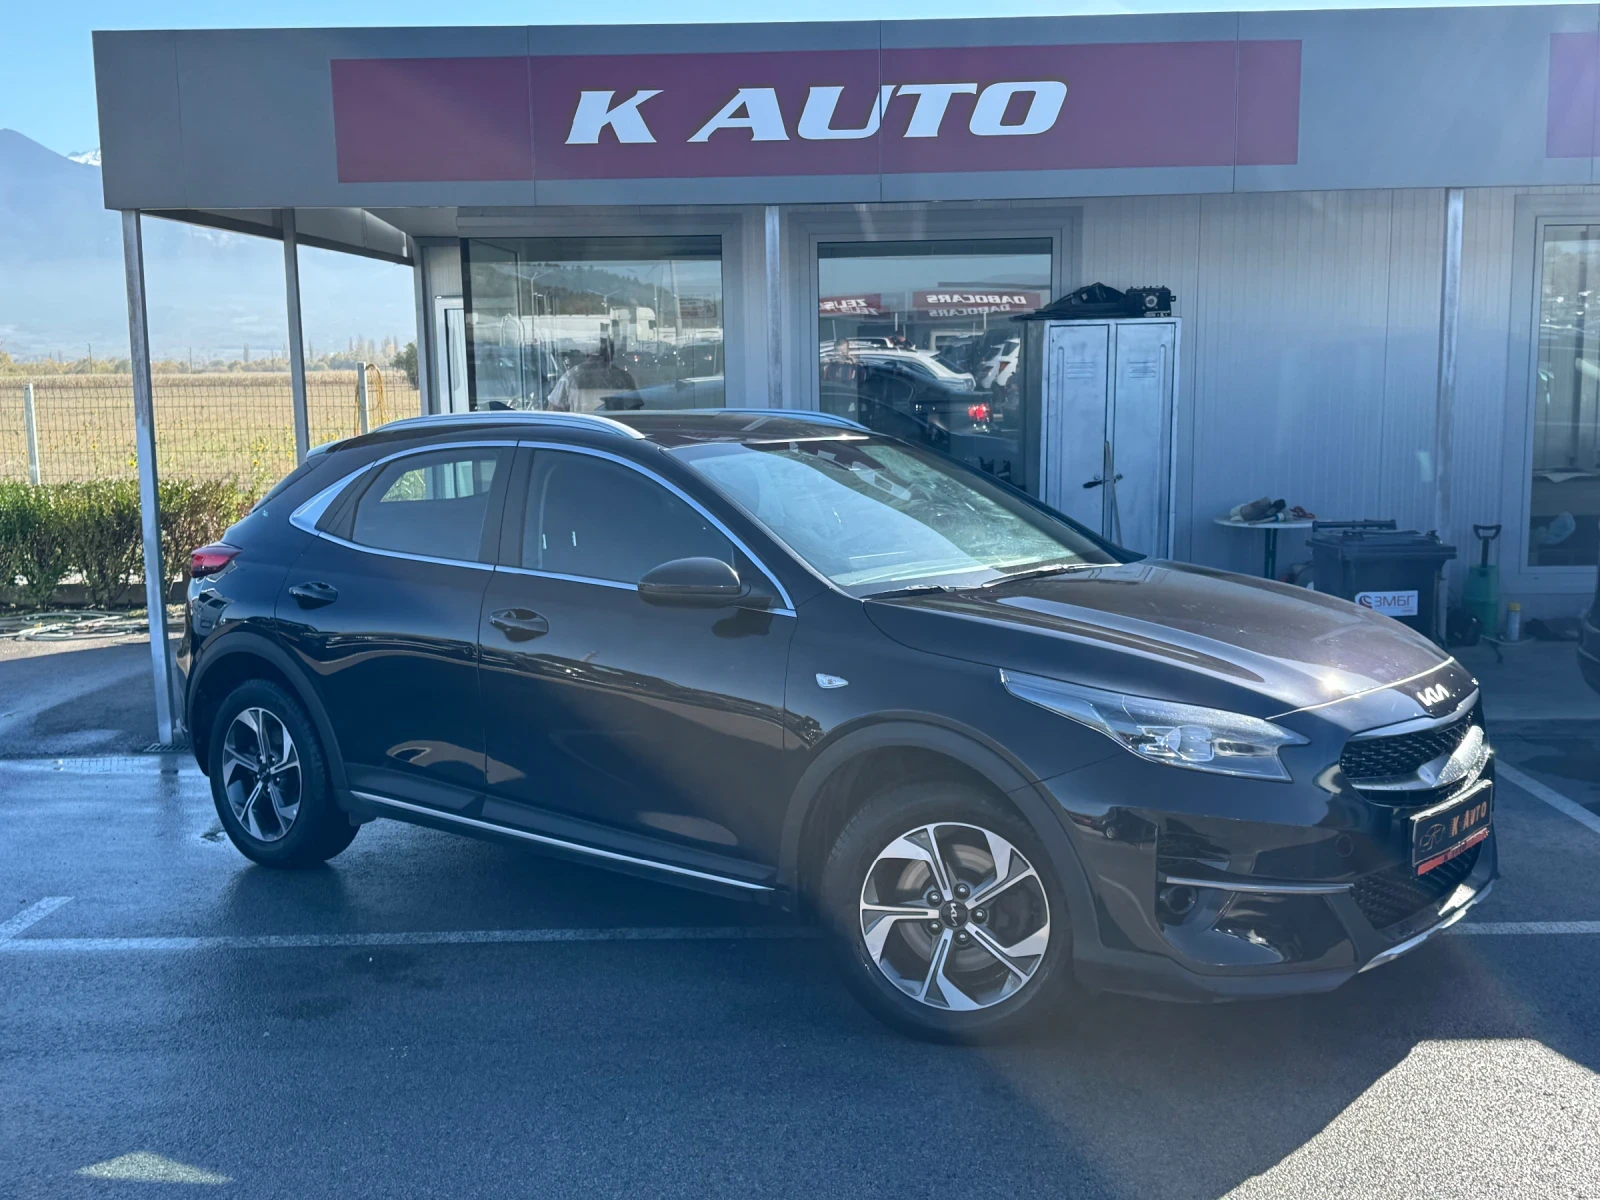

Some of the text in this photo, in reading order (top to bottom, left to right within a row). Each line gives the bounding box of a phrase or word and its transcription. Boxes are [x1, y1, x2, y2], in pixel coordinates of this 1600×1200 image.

[565, 80, 1068, 143] K AUTO
[1374, 594, 1415, 608] ЗМБГ
[1416, 683, 1450, 707] KIA
[1449, 815, 1460, 837] K
